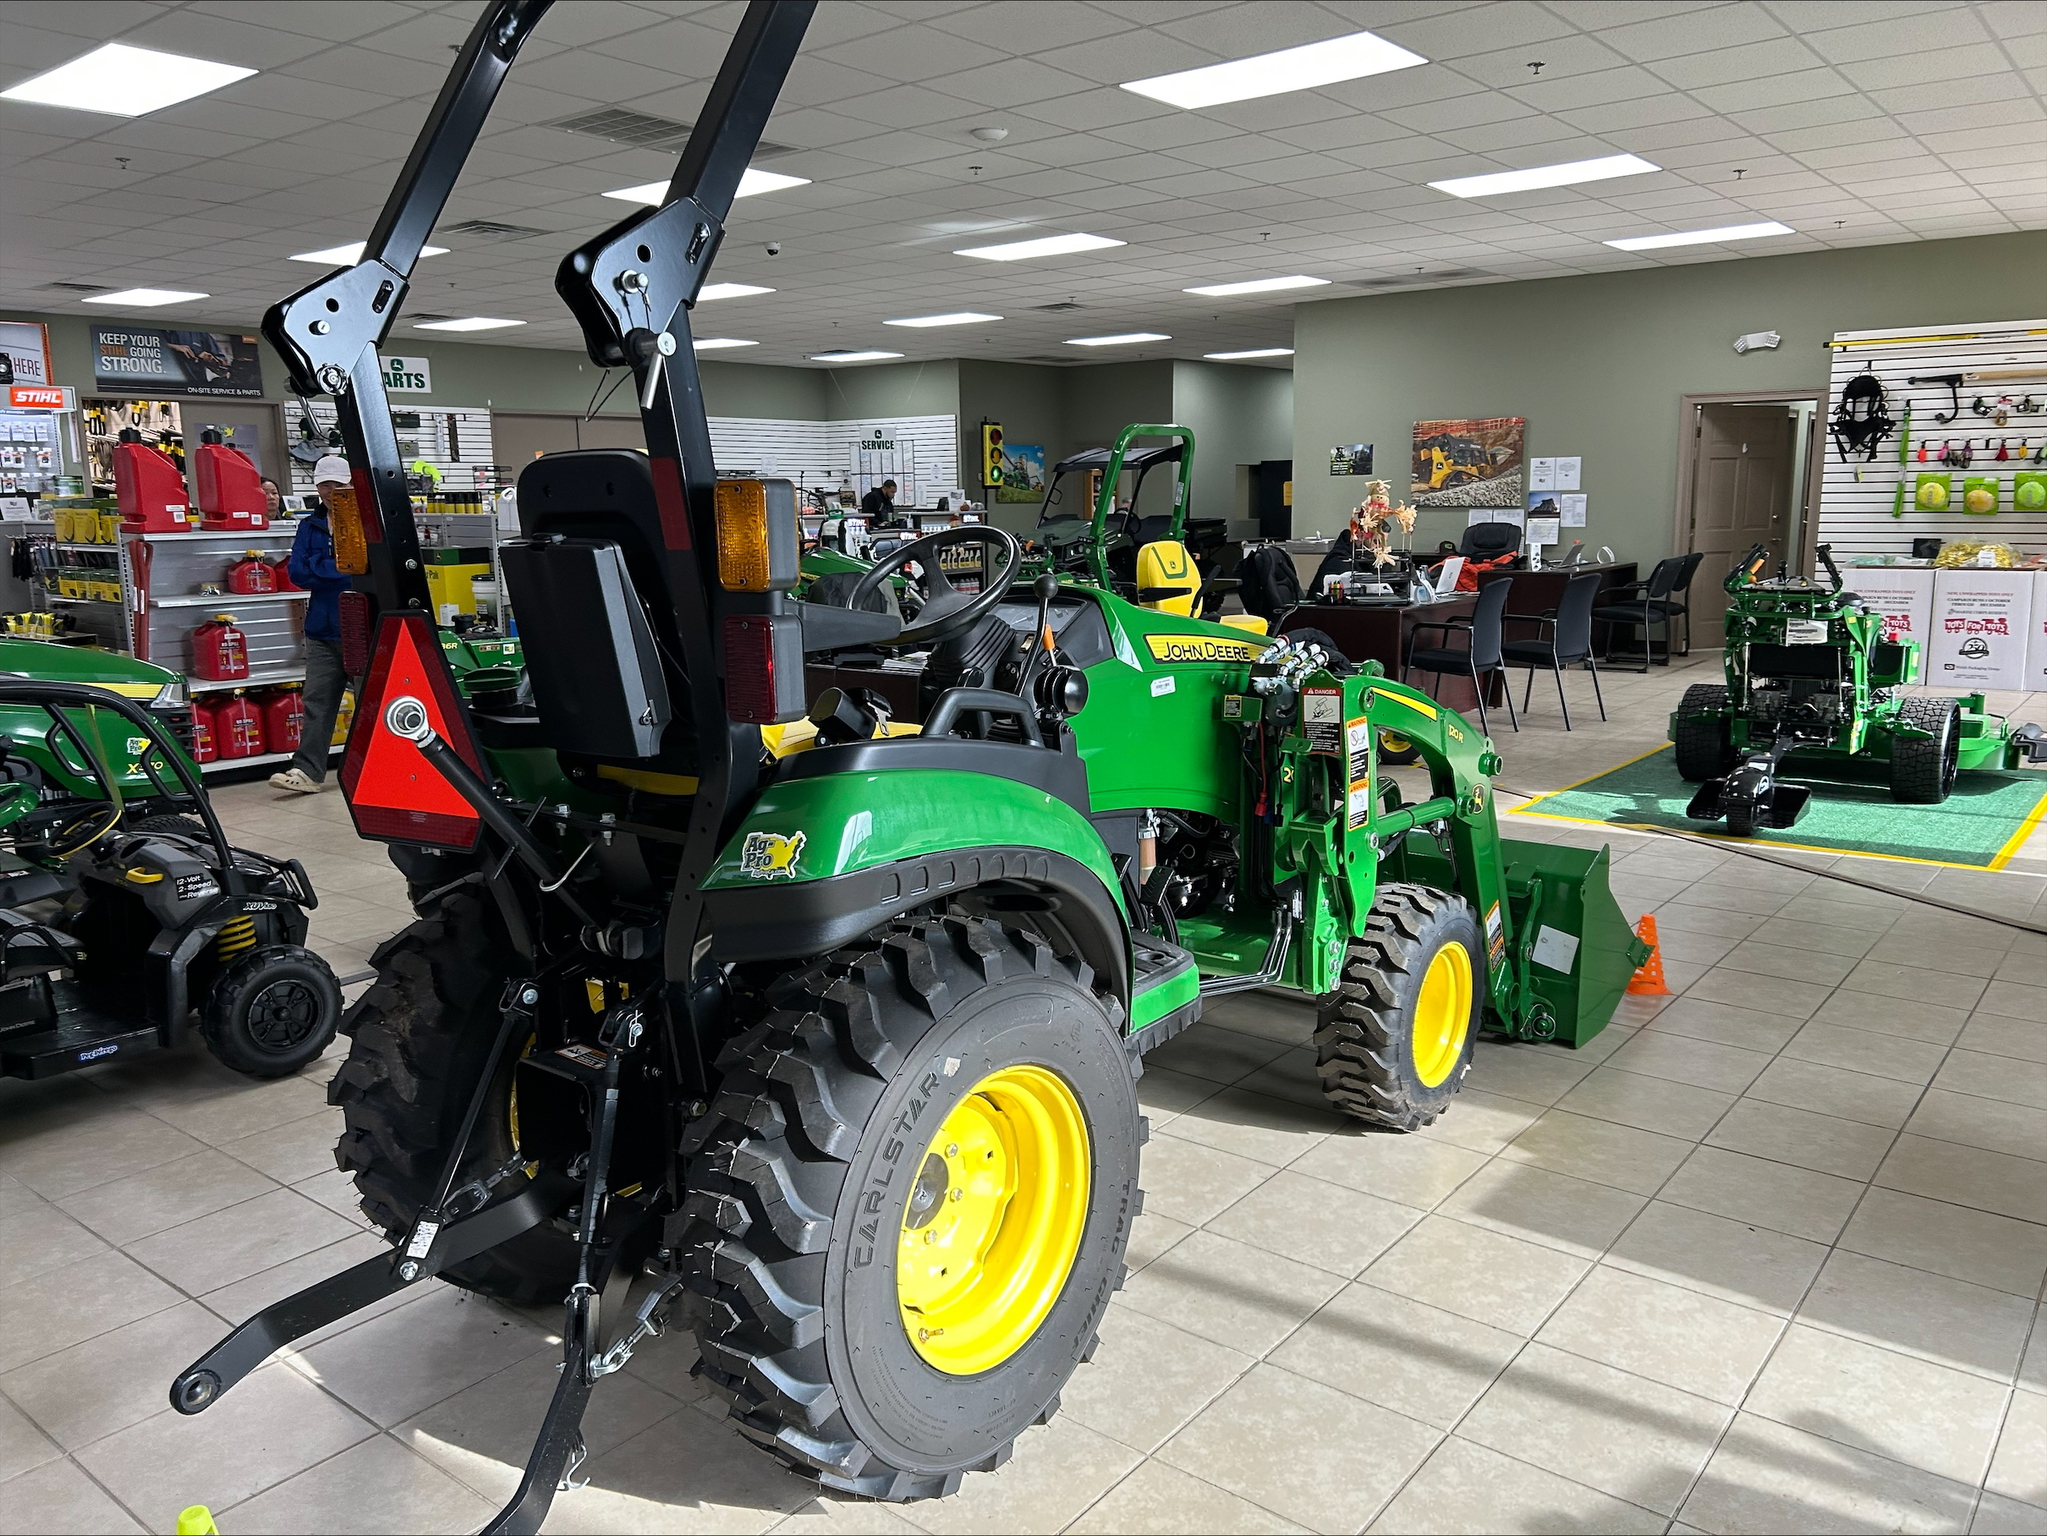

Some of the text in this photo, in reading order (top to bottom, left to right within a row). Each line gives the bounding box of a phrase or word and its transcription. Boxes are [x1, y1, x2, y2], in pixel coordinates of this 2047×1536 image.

[99, 332, 160, 347] KEEP YOUR
[100, 345, 161, 358] STIHL GOING
[13, 357, 41, 377] HERE
[101, 356, 167, 374] STRONG.
[383, 372, 425, 389] ARTS
[15, 391, 61, 404] STIHL
[861, 440, 895, 450] SERVICE
[1889, 620, 1908, 628] TOTS
[1946, 620, 2006, 631] TOYS FOR TOTS
[1163, 641, 1251, 660] JOHN DEERE
[126, 761, 164, 774] X0
[746, 836, 775, 854] Ag-
[744, 852, 773, 868] Pro
[176, 875, 202, 886] 12-Volt
[178, 880, 212, 893] 2-Speed
[853, 1071, 941, 1270] CARLSTAR
[1111, 1178, 1131, 1255] TRAC
